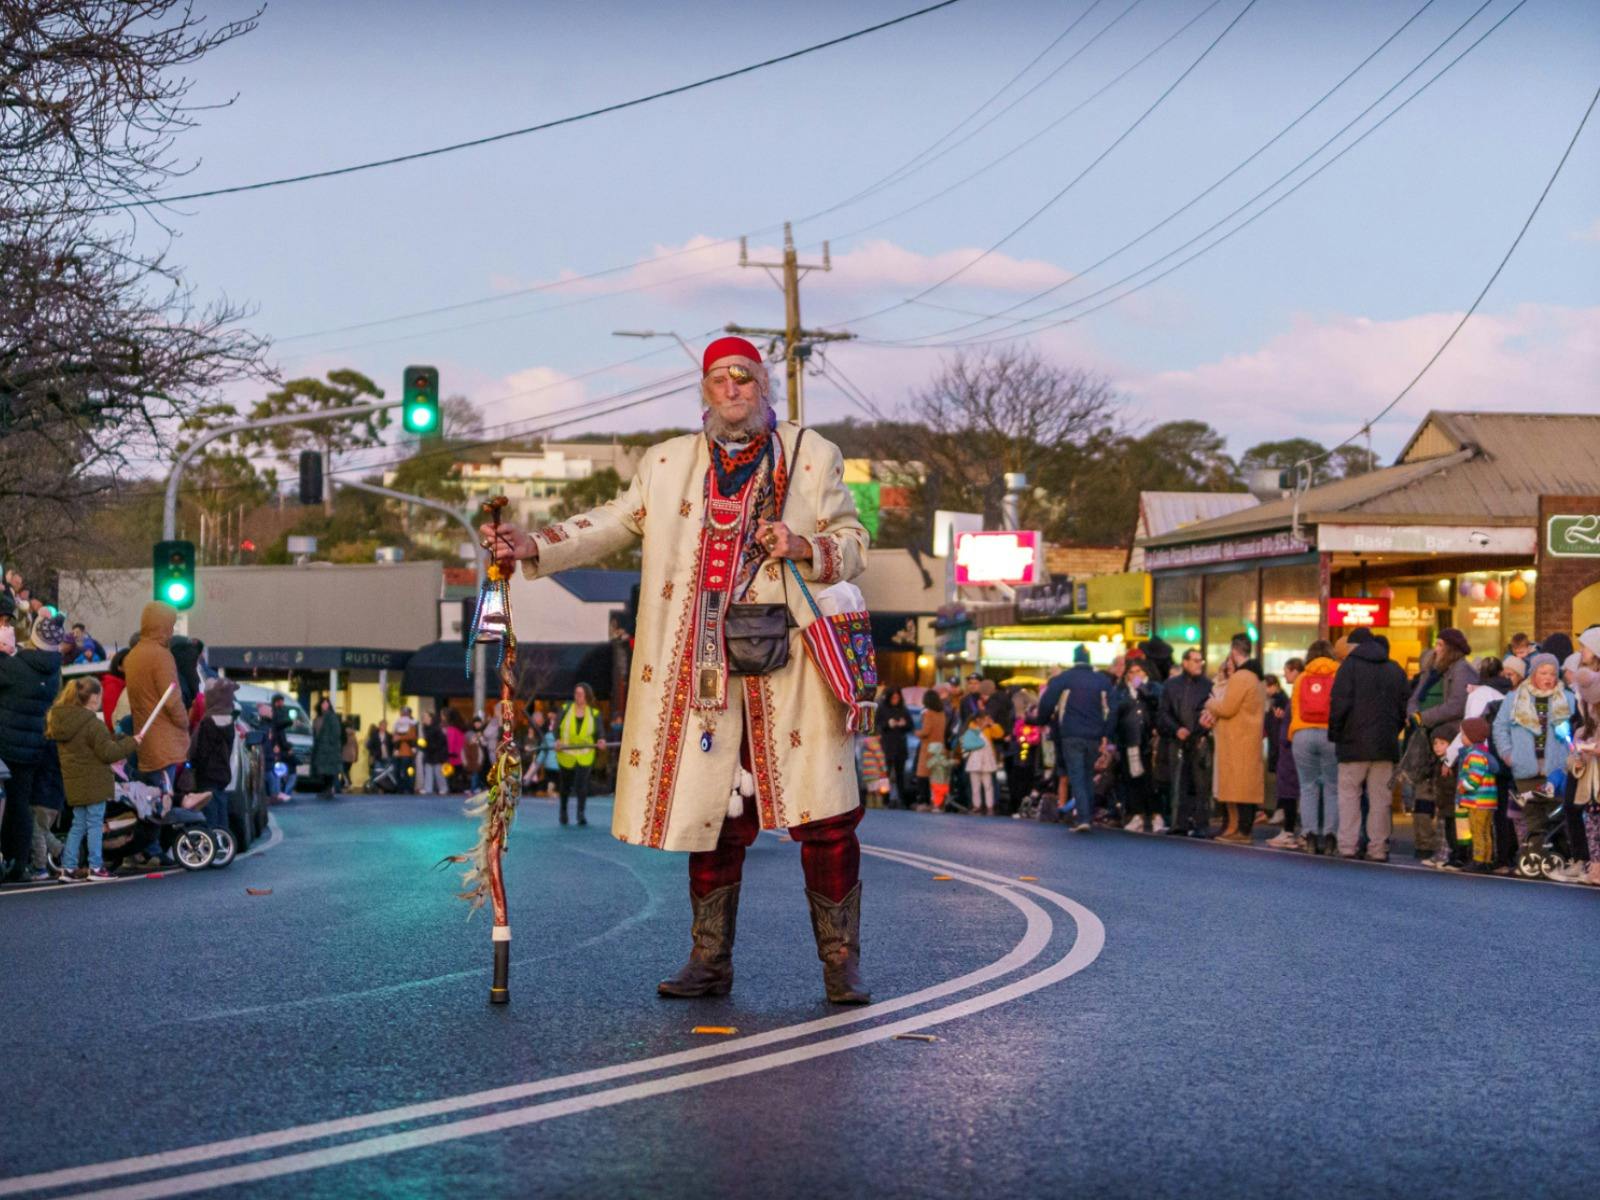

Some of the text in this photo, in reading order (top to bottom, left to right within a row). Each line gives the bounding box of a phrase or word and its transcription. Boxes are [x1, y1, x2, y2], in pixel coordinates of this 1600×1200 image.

[1354, 535, 1452, 549] Base Bar
[345, 653, 390, 665] RUSTIC
